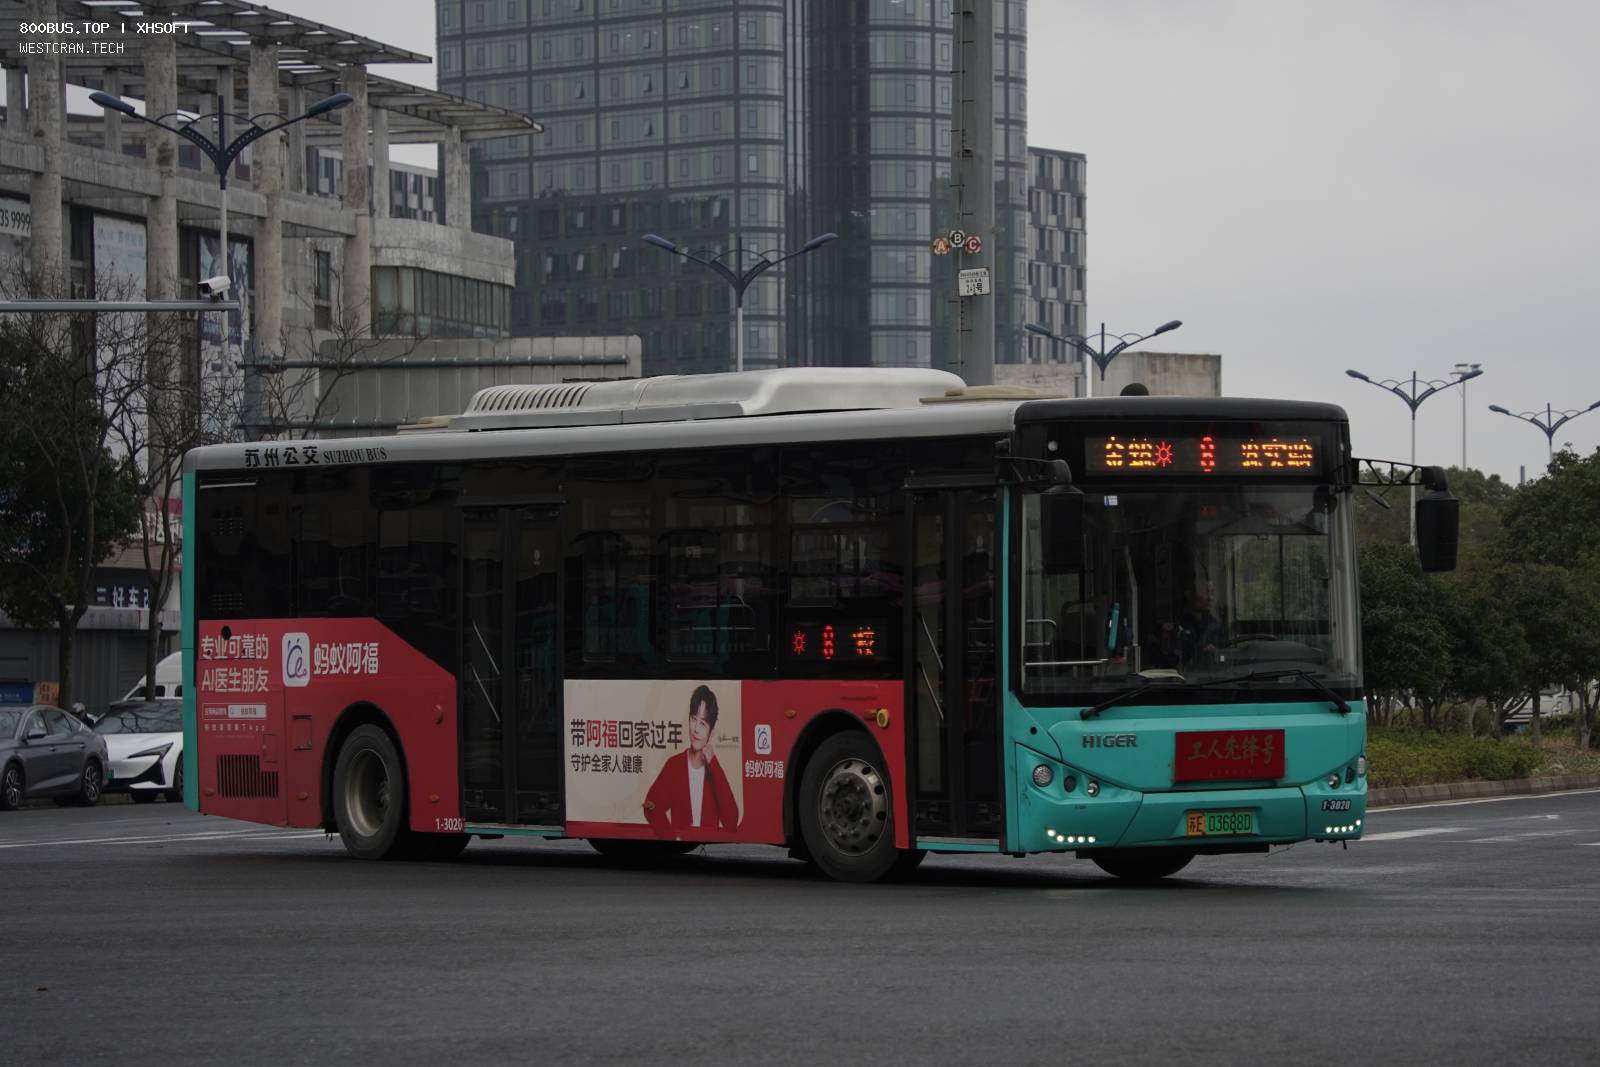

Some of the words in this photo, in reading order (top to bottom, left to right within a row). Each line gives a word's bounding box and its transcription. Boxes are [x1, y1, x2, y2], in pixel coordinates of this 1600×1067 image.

[11, 210, 31, 232] 9999
[245, 446, 319, 467] 苏州公交
[323, 448, 366, 464] SUZHOU
[367, 447, 387, 461] BUS
[200, 634, 269, 660] 专业可靠的
[313, 642, 379, 675] 蚂蚁阿福
[201, 667, 269, 693] AI医生朋友
[570, 719, 683, 750] 带阿福回家过年
[1082, 734, 1137, 749] HIGER
[1184, 734, 1275, 765] 工人先锋号
[570, 754, 643, 774] 守护全家人健康
[744, 760, 784, 779] 蚂蚁阿福
[1322, 799, 1351, 811] 1-3020
